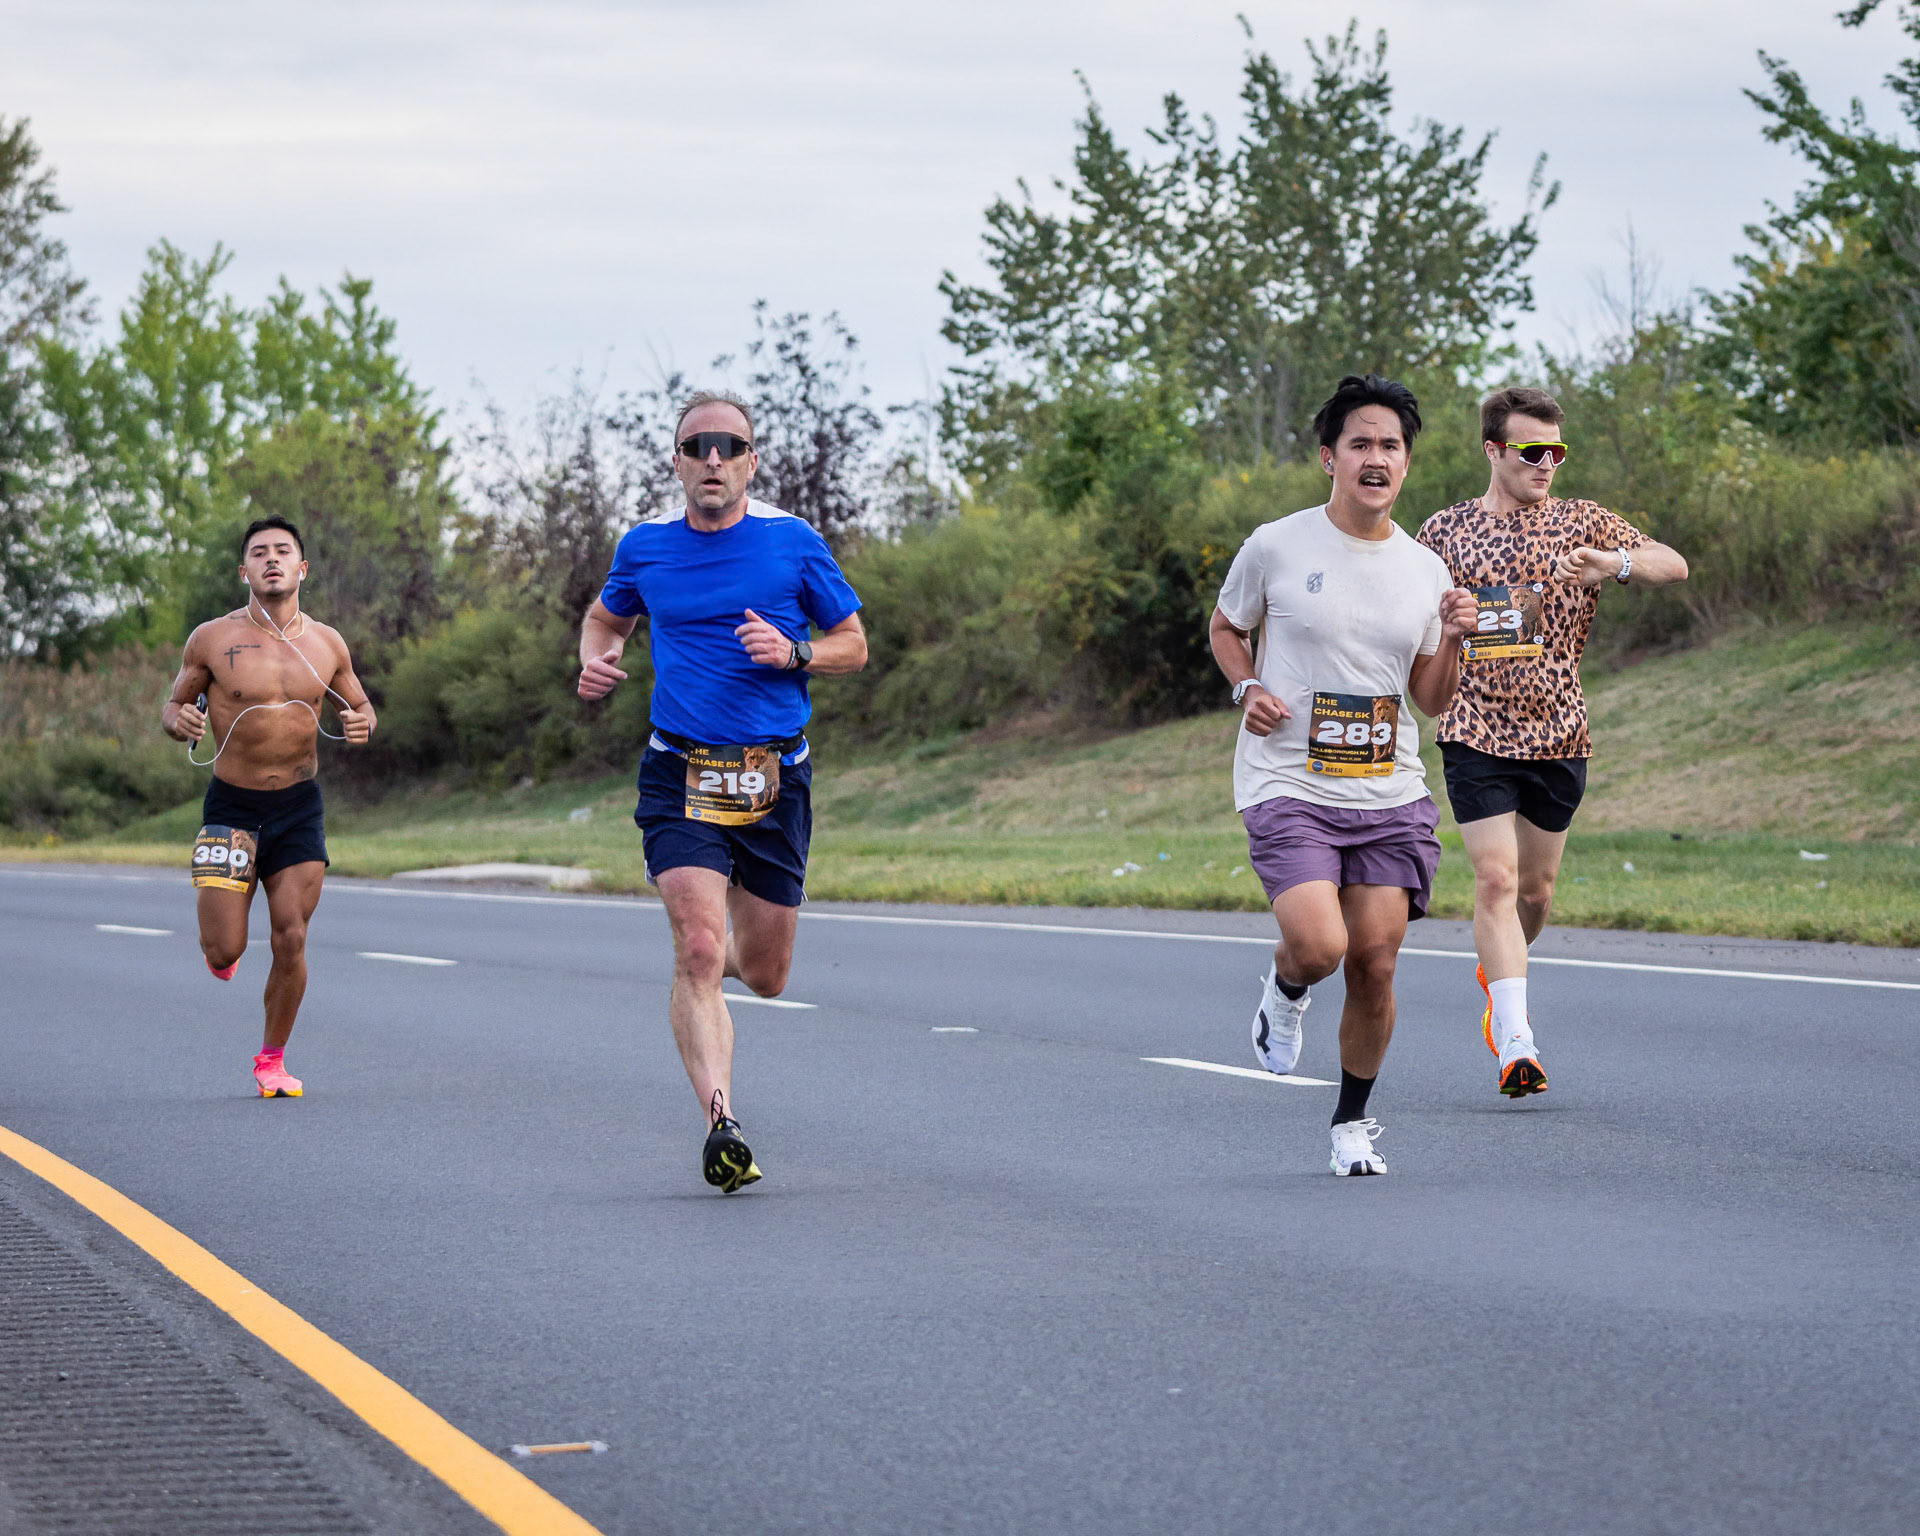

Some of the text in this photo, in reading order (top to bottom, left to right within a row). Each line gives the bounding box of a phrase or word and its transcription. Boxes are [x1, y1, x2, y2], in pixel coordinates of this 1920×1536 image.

[1477, 610, 1522, 632] 23
[1314, 708, 1353, 718] CHASE
[1315, 698, 1338, 706] THE
[1316, 720, 1392, 746] 283
[689, 758, 724, 768] CHASE
[698, 770, 766, 794] 219
[194, 845, 249, 868] 390
